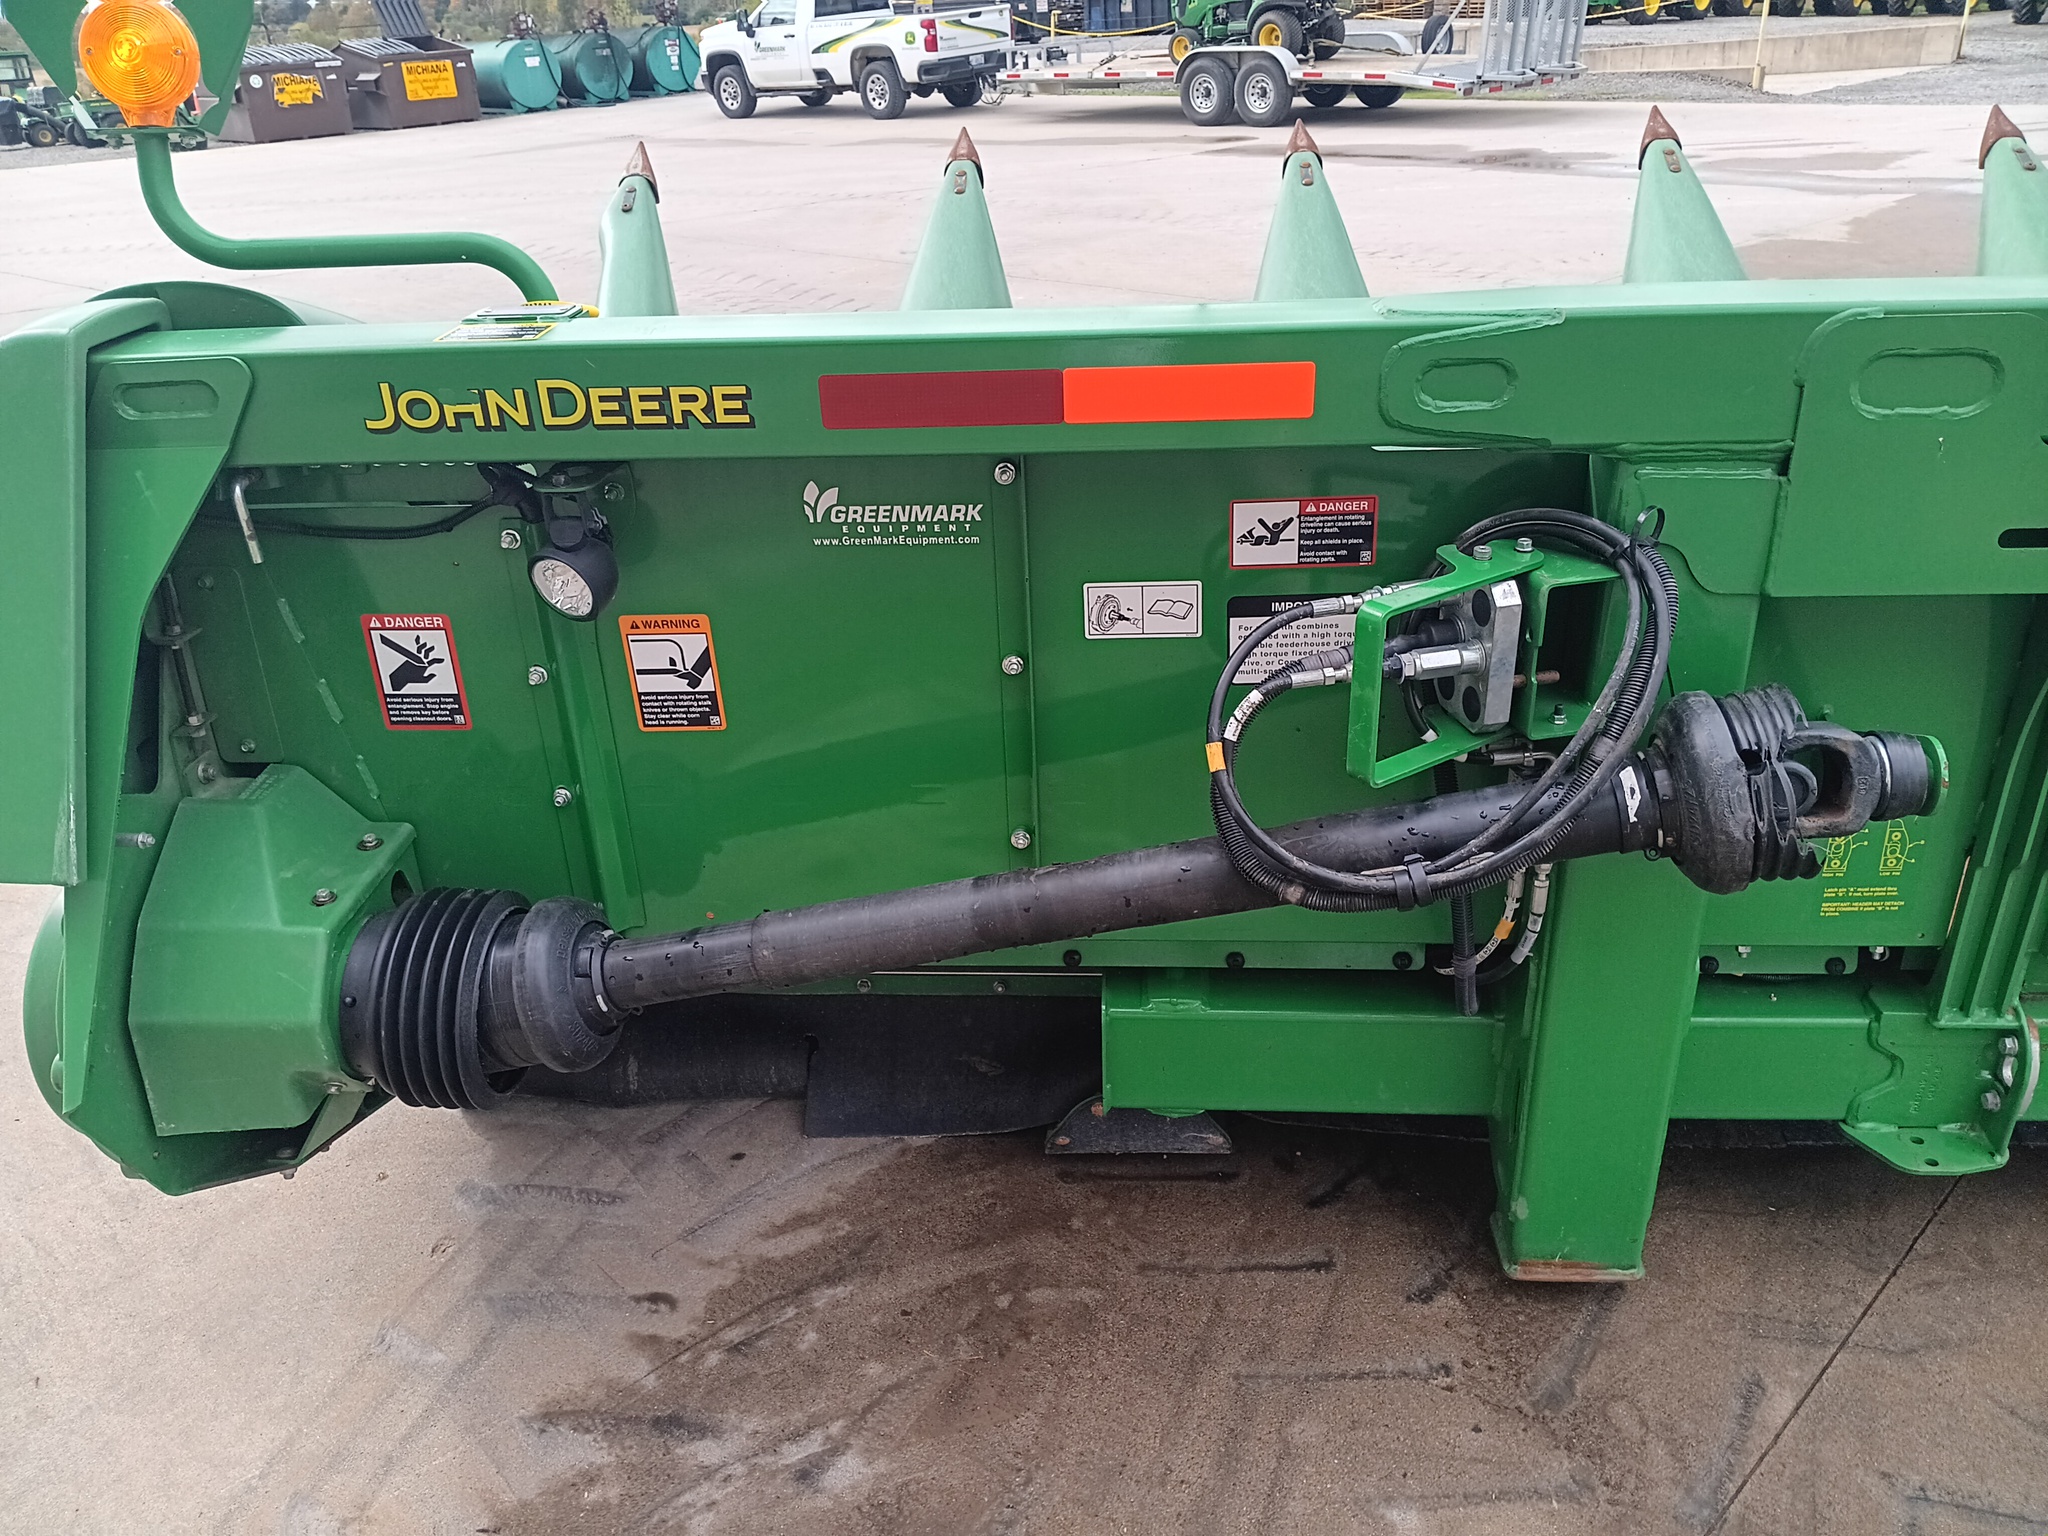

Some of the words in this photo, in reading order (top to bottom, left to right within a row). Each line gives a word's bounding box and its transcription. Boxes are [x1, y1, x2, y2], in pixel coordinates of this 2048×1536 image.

[405, 63, 449, 75] MICHIANA
[535, 378, 756, 430] DEERE
[1319, 501, 1368, 512] DANGER
[830, 504, 984, 523] GREENMARK
[1344, 514, 1365, 522] rotating
[842, 524, 972, 533] EQUIPMENT
[813, 535, 980, 546] www.GreenMarkEquipment.com
[384, 617, 444, 628] DANGER
[641, 619, 701, 629] WARNING
[1295, 622, 1340, 631] combines
[1311, 631, 1331, 640] high
[1276, 641, 1331, 649] feederhouse
[666, 719, 689, 727] running.
